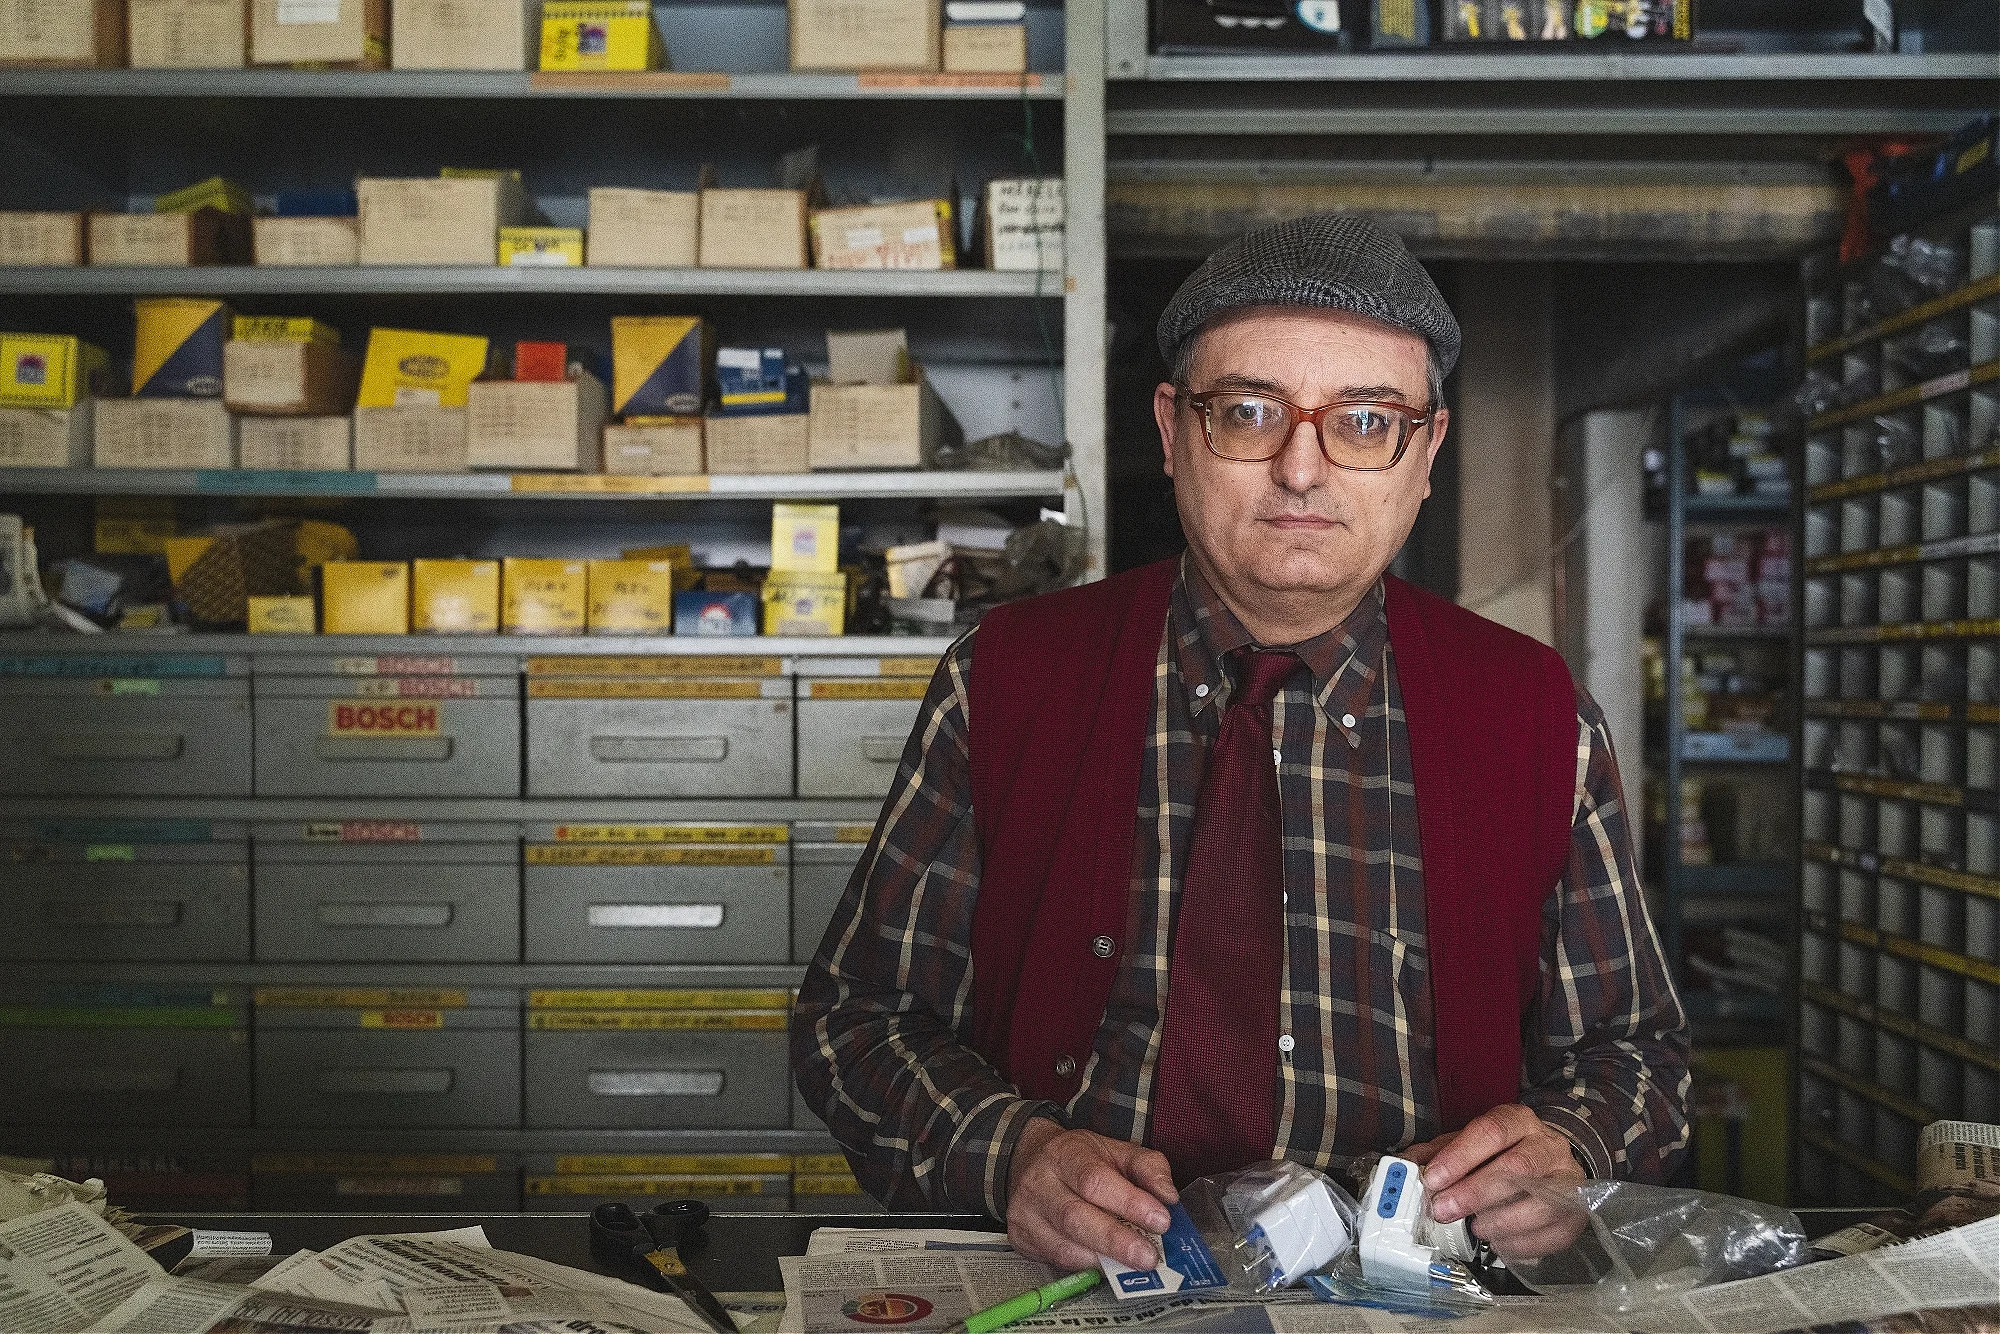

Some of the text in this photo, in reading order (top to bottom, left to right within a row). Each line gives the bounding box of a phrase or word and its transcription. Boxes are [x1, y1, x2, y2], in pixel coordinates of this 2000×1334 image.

[335, 705, 437, 731] BOSCH
[1112, 1314, 1132, 1325] ci
[1135, 1306, 1166, 1321] chi
[1060, 1317, 1079, 1328] la
